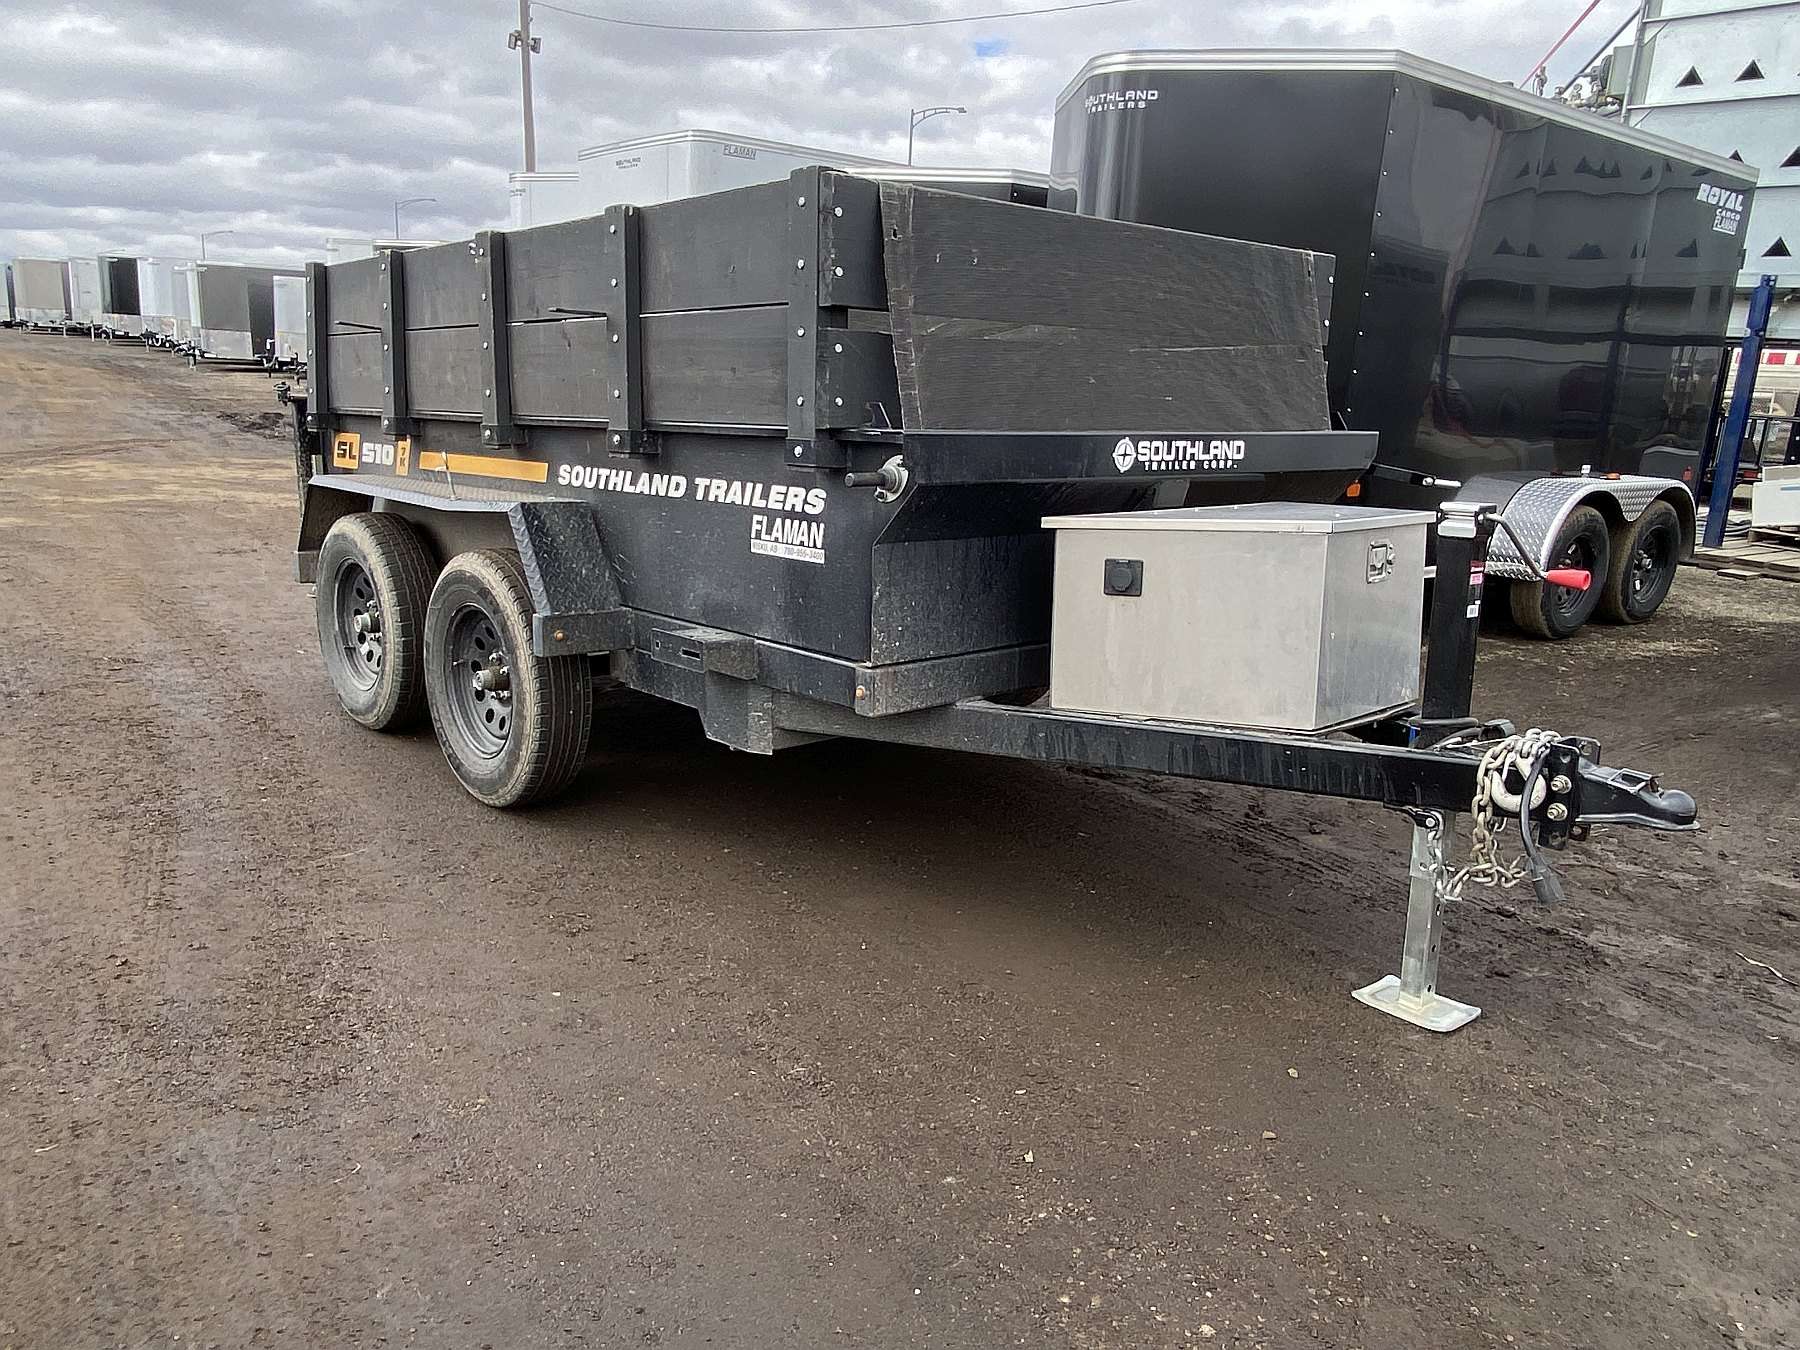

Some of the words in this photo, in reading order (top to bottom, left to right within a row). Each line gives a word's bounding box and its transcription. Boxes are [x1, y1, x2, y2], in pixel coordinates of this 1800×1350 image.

[723, 144, 755, 159] FLAMAN
[1696, 183, 1744, 211] ROYAL
[1716, 208, 1740, 221] CARGO
[337, 441, 357, 460] SL
[361, 442, 394, 466] 510
[1137, 440, 1245, 461] SOUTHLAND
[1144, 460, 1196, 471] TRAILER
[1203, 460, 1238, 470] CORP.
[557, 465, 687, 498] SOUTHLAND
[694, 477, 827, 514] TRAILERS
[751, 515, 825, 549] FLAMAN
